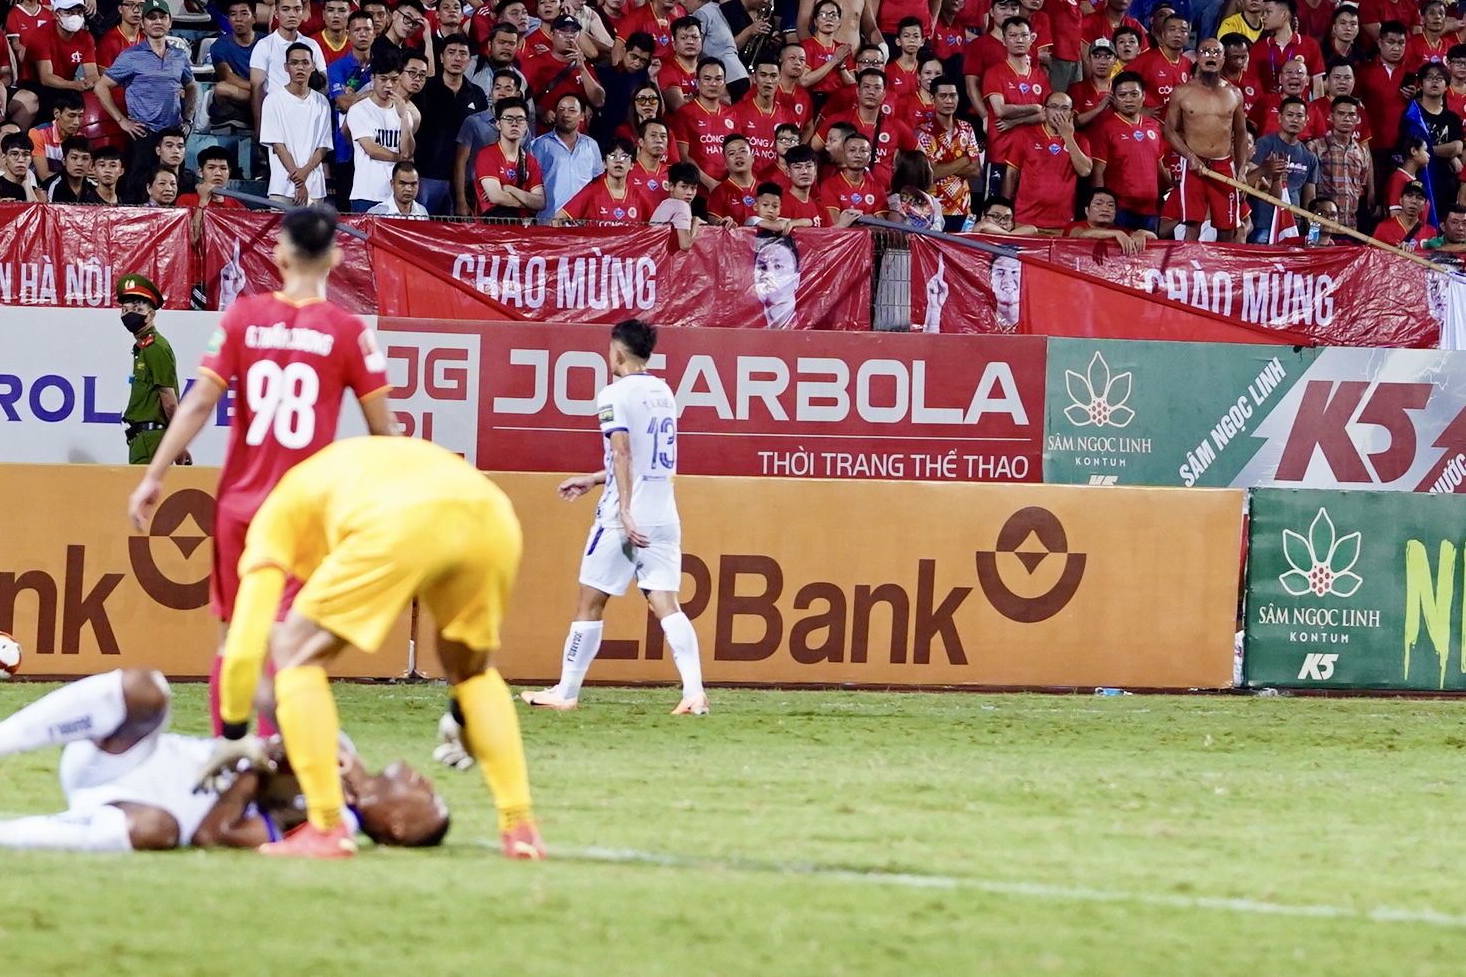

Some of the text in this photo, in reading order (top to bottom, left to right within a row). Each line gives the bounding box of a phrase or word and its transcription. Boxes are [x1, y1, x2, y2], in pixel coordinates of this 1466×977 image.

[700, 134, 724, 144] CÔNG
[20, 254, 58, 305] HÀ
[451, 245, 657, 311] CHÀO MỪNG
[1144, 260, 1335, 326] CHÀO MỪNG
[246, 360, 320, 450] 98
[494, 348, 1030, 426] JOARBOLA
[647, 417, 675, 470] 13
[1047, 433, 1152, 455] SÂM NGỌC LINH
[1179, 356, 1287, 488] SÂM NGỌC LINH
[1274, 379, 1434, 483] K5
[757, 445, 1030, 479] THỜI TRANG THỂ THAO
[1075, 456, 1126, 467] KONTUM
[1258, 605, 1381, 629] SÂM NGỌC LINH
[1290, 632, 1349, 644] KONTUM
[1402, 538, 1466, 688] N
[1297, 653, 1339, 681] K5
